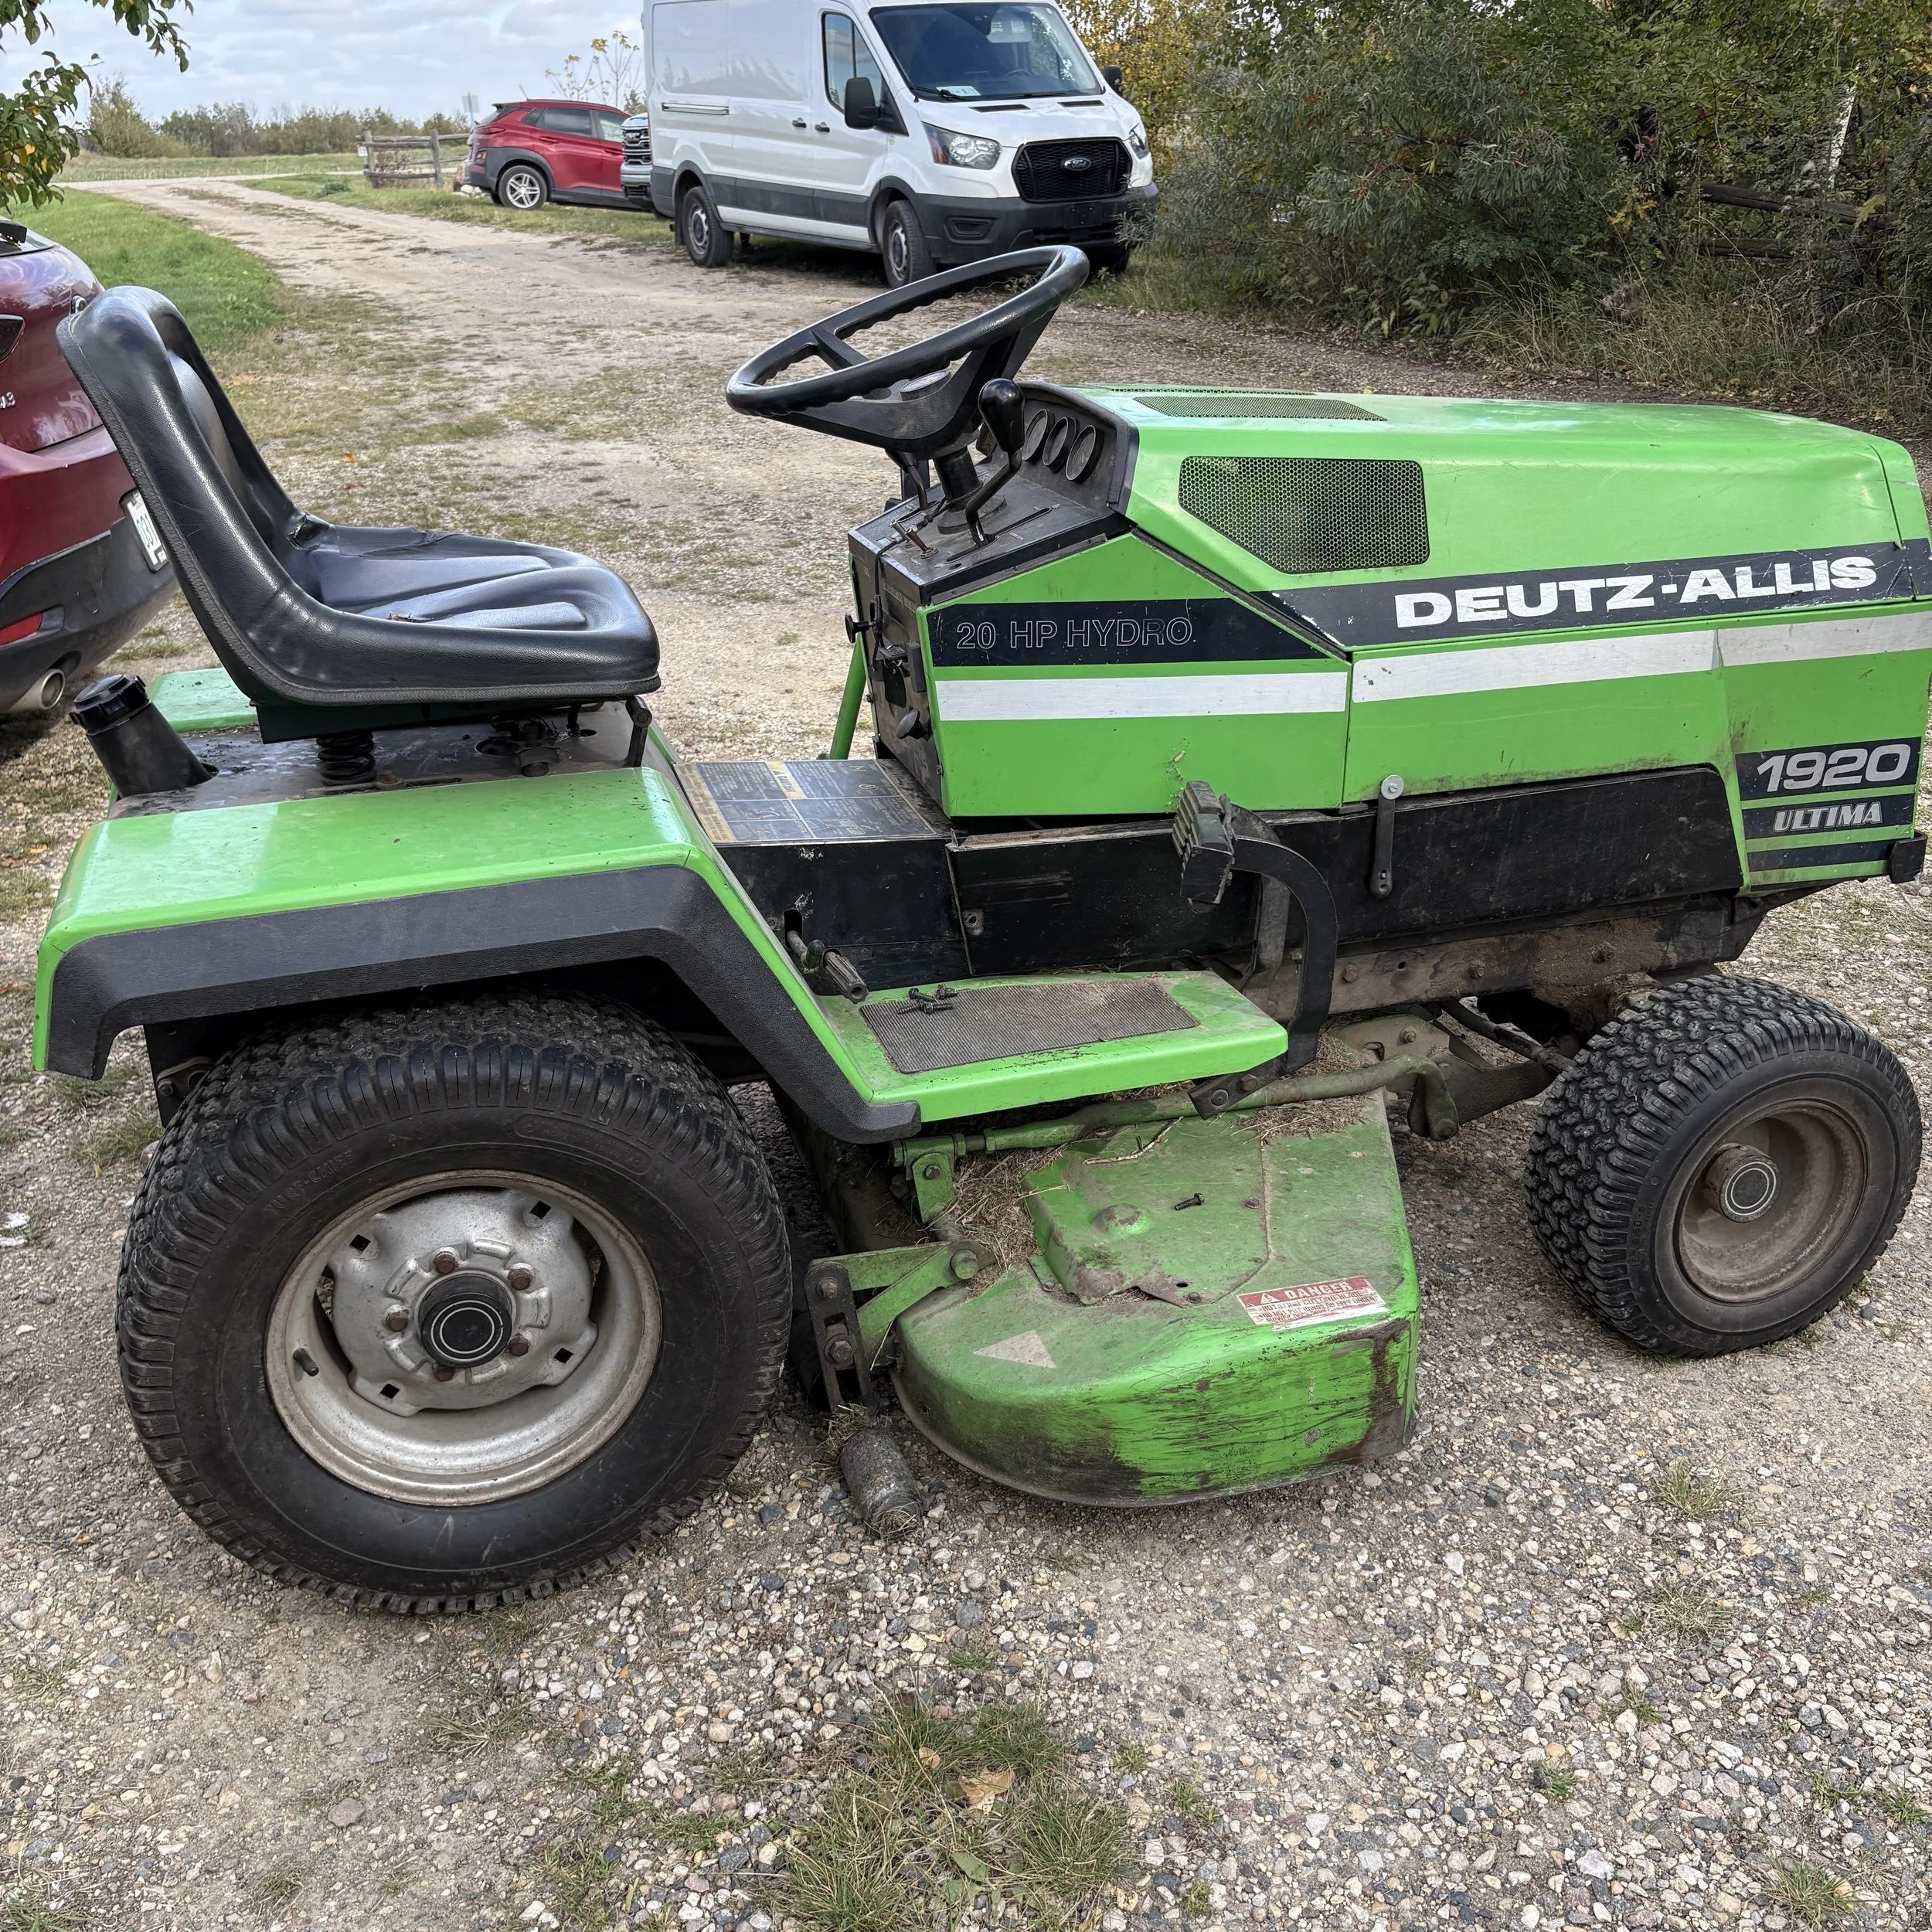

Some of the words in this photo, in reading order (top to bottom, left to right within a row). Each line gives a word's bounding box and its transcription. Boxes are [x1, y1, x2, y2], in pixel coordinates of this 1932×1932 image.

[1394, 556, 1878, 628] DEUTZ-ALLIS
[957, 621, 996, 649] 20
[1010, 621, 1058, 648] HP
[1067, 617, 1192, 648] HYDRO
[1757, 743, 1911, 793] 1920
[1773, 801, 1883, 833] ULTIMA
[1284, 1281, 1353, 1300] DANGER
